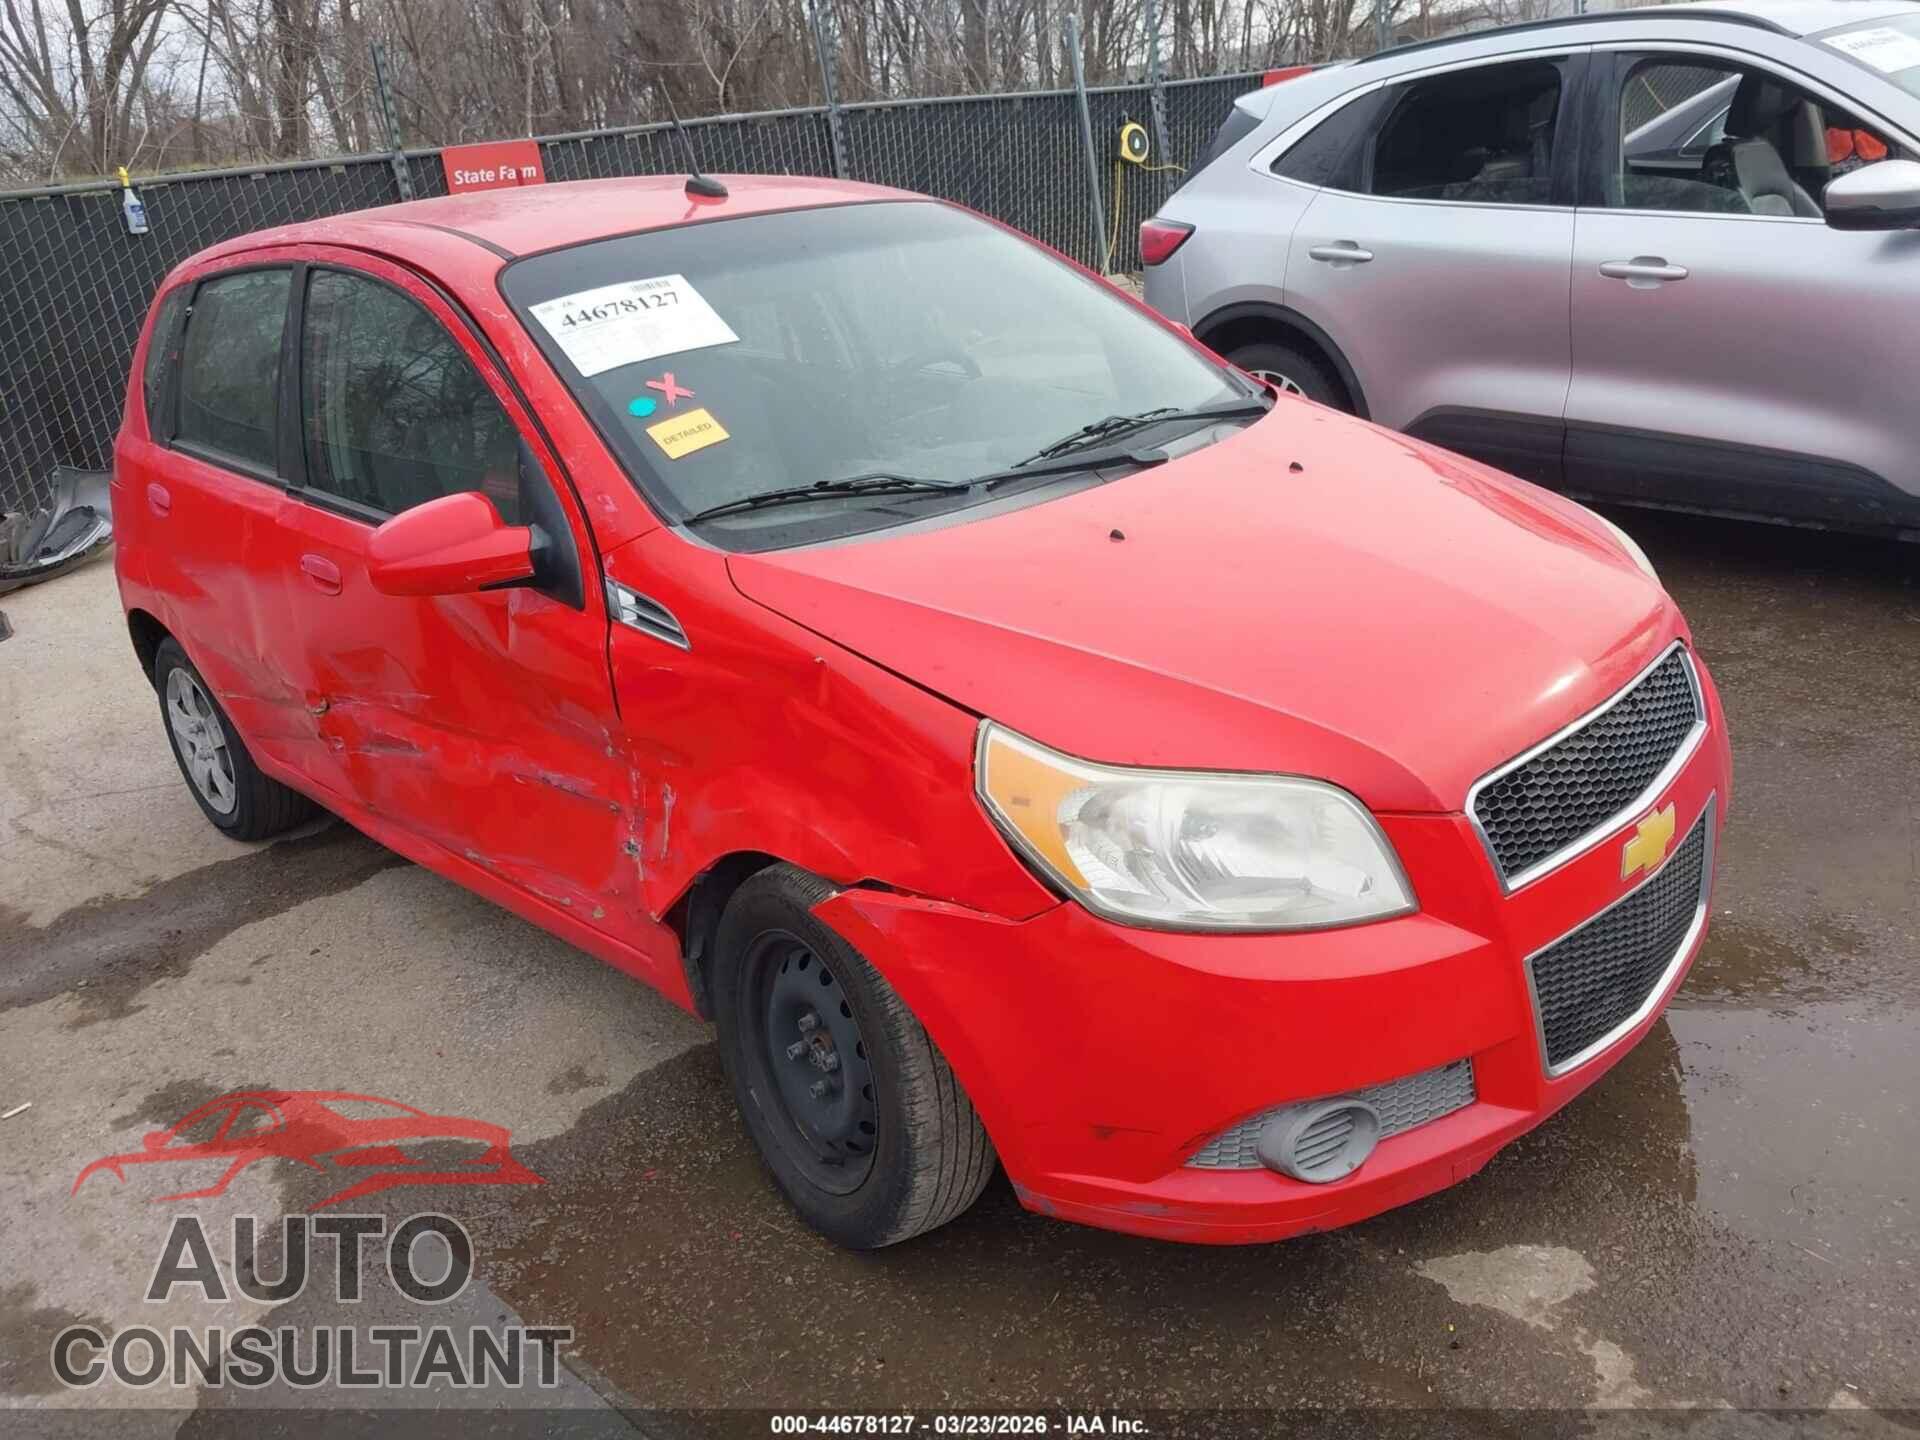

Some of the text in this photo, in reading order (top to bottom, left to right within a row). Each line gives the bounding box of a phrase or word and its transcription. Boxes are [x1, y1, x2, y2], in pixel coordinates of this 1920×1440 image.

[454, 165, 537, 185] State Fam
[562, 291, 678, 326] 44678127
[663, 422, 712, 445] DETAILED
